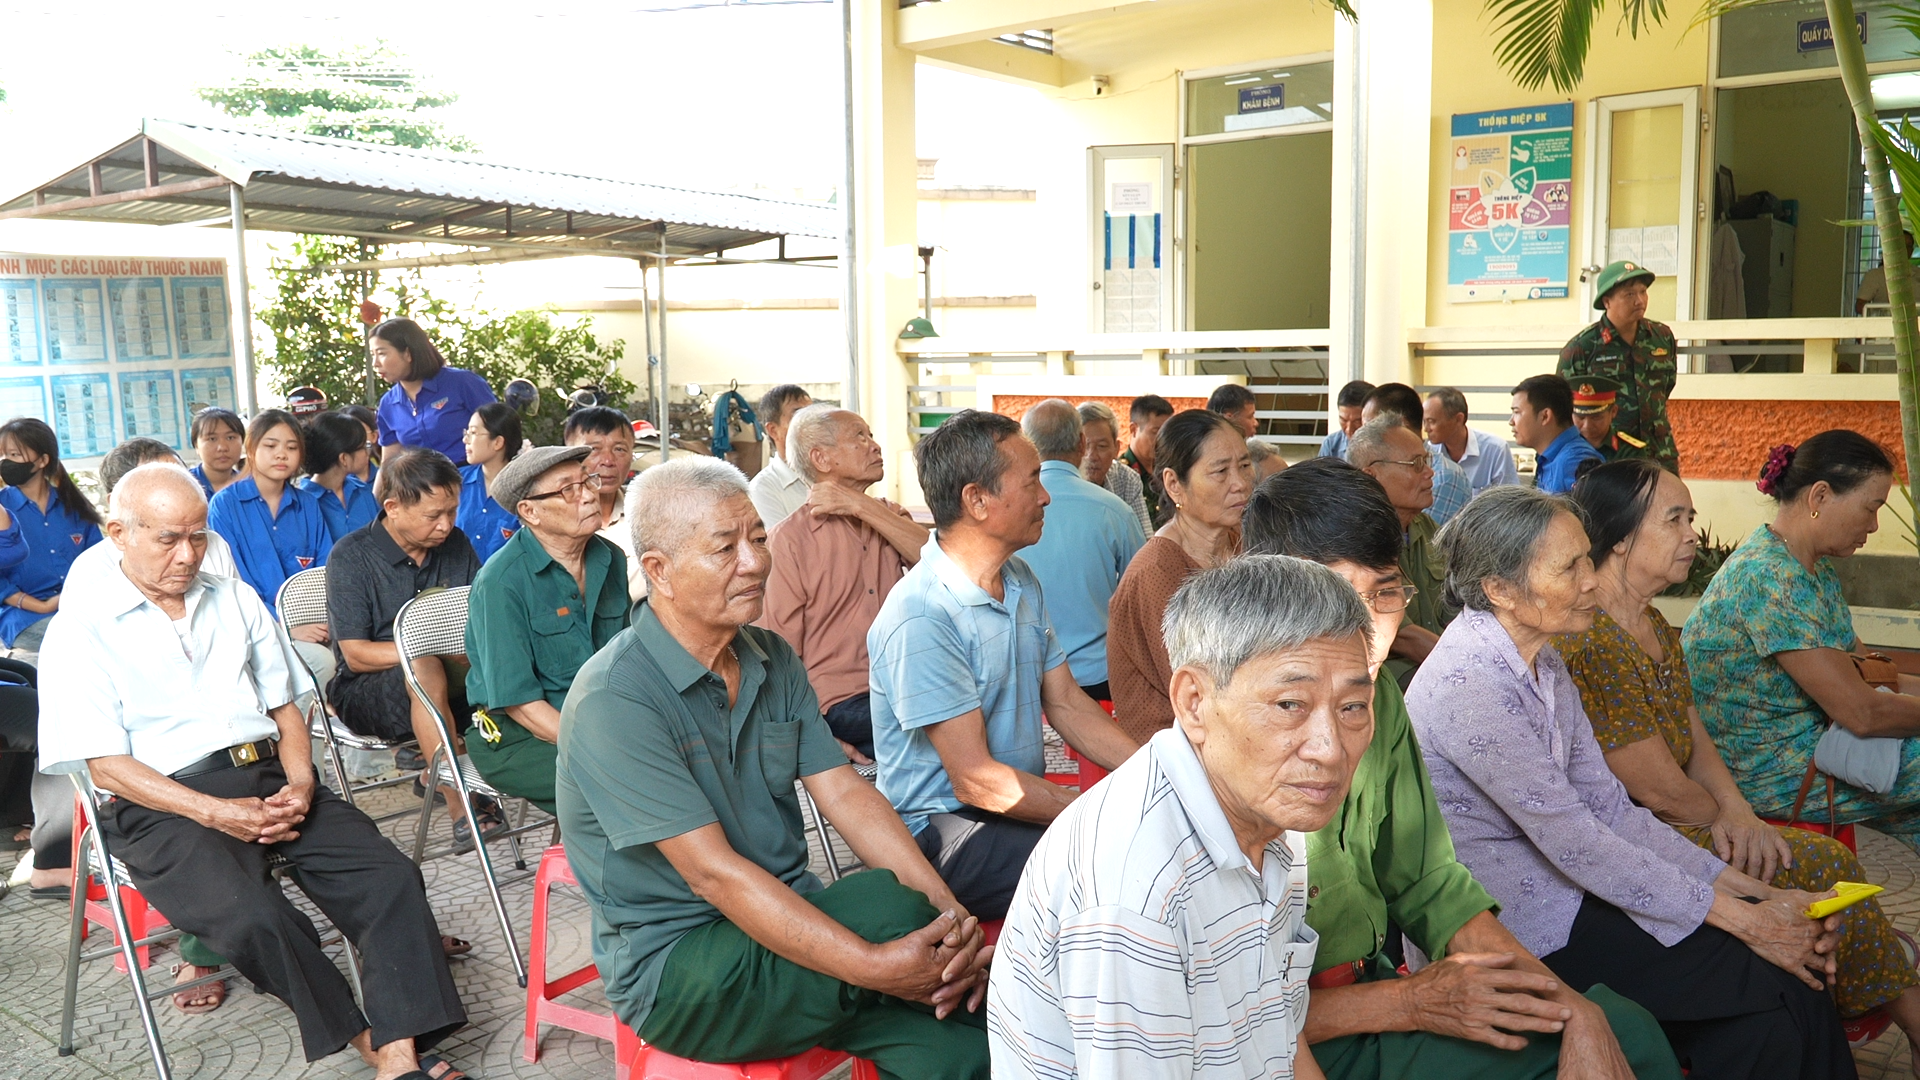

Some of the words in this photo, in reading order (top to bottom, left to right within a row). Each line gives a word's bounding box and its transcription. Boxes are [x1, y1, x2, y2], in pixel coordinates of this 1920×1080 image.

[1262, 96, 1280, 109] BỆNH
[1535, 112, 1547, 122] 5K
[1492, 203, 1519, 220] 5K
[26, 258, 57, 278] MỤC
[61, 257, 89, 275] CÁC
[90, 259, 119, 278] LOẠI
[120, 258, 143, 275] CÂY
[189, 260, 223, 275] NAM
